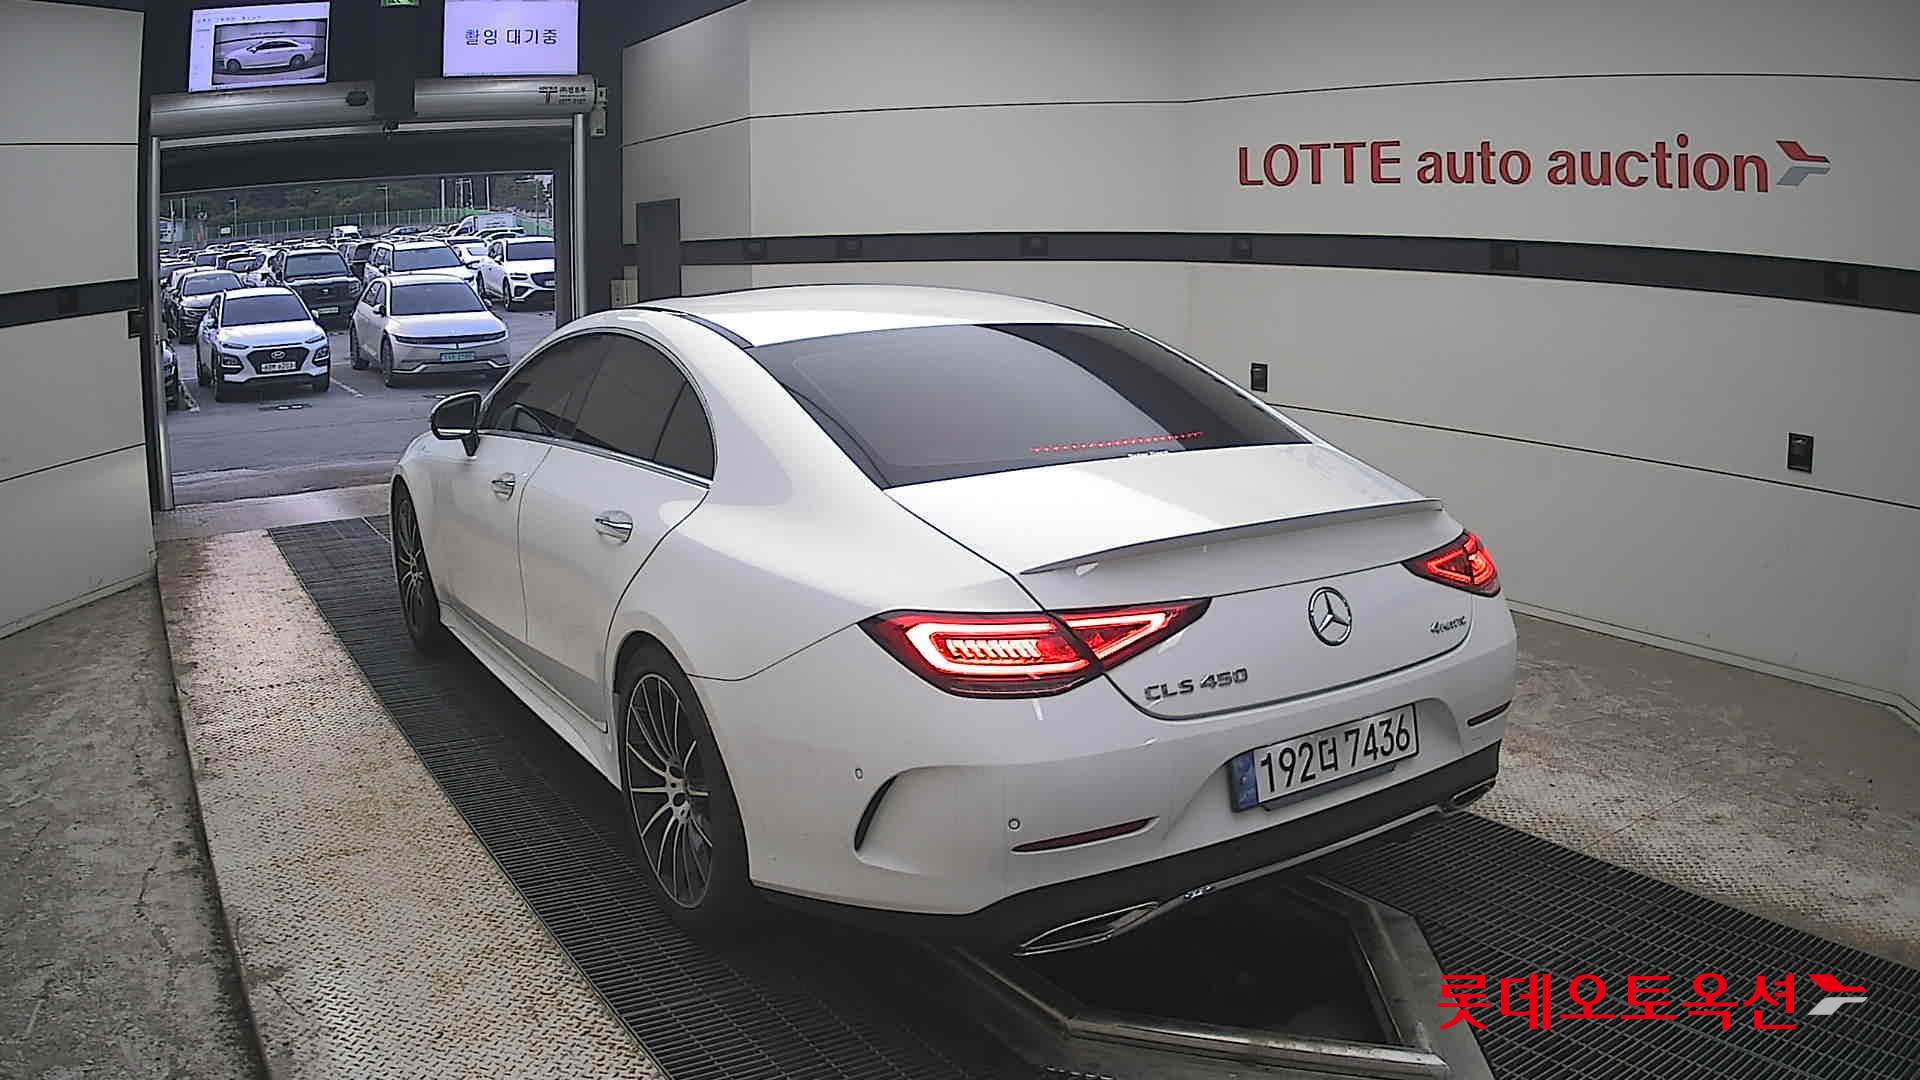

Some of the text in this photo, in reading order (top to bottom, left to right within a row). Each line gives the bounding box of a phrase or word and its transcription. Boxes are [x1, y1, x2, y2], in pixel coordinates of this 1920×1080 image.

[506, 29, 557, 45] 대기중
[1238, 133, 1770, 193] LOTTE auto auction
[1144, 667, 1249, 702] CLS 450
[1259, 713, 1411, 794] 192더 7436
